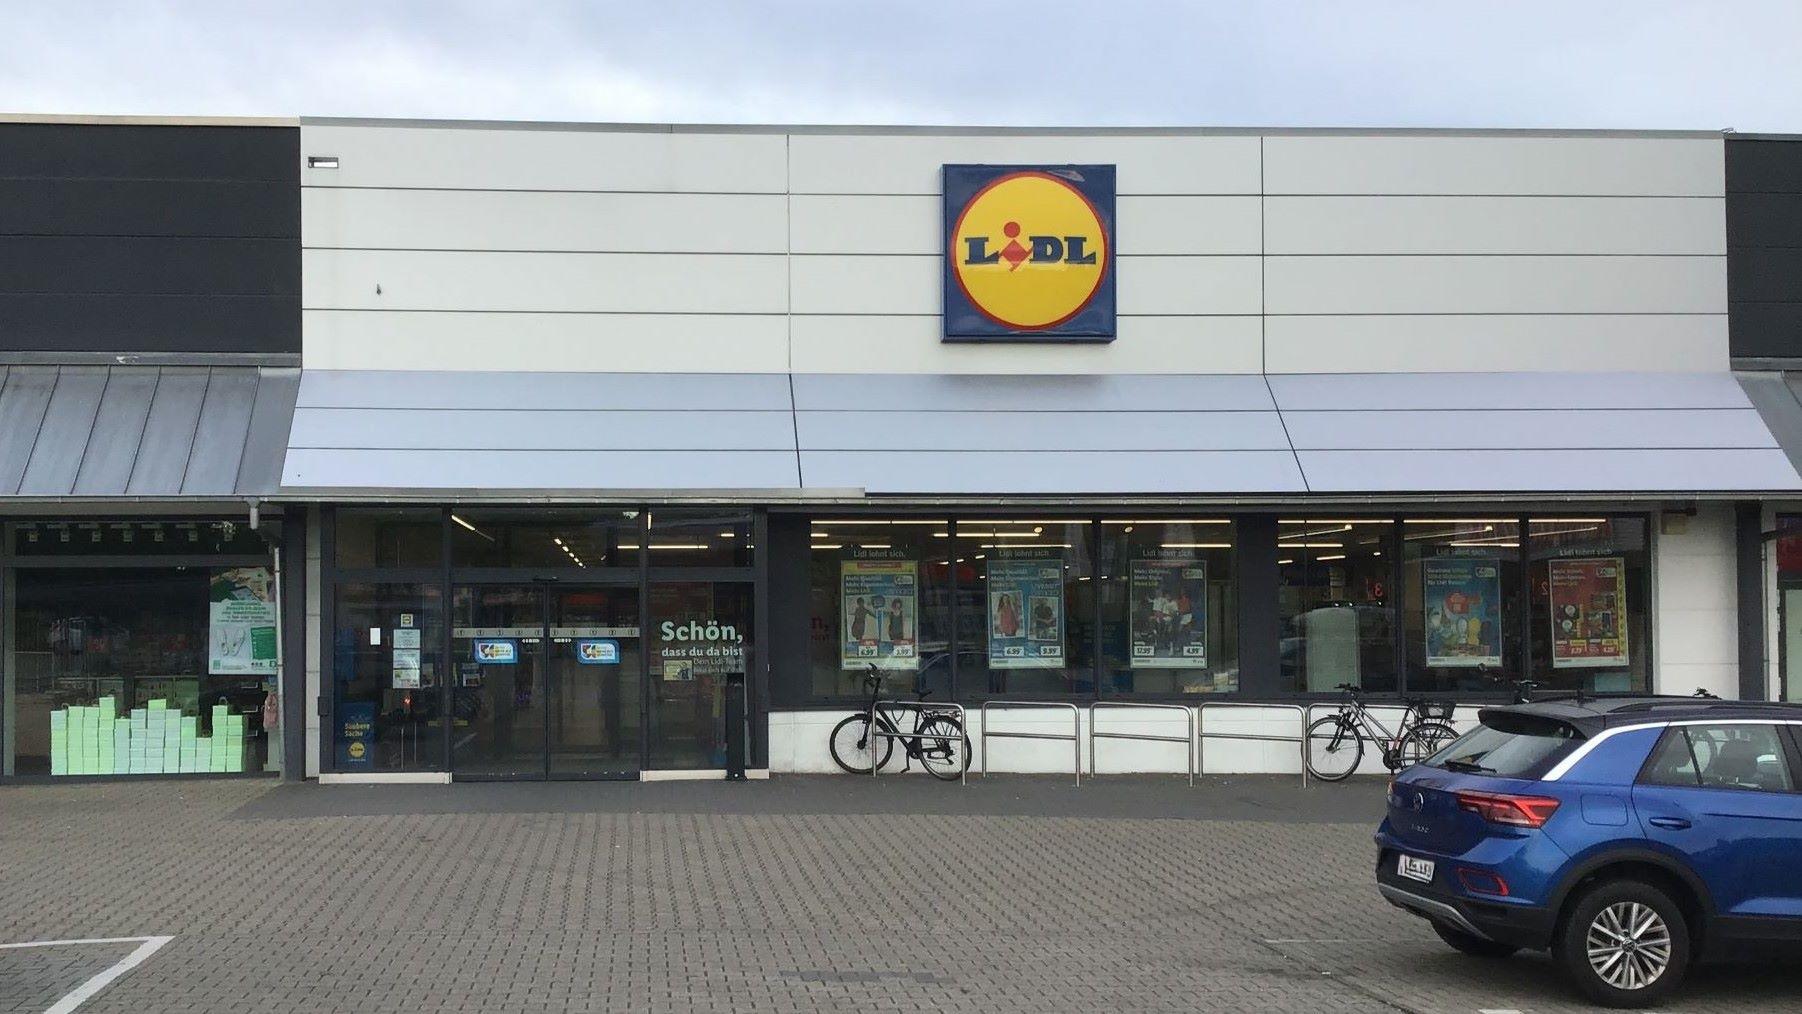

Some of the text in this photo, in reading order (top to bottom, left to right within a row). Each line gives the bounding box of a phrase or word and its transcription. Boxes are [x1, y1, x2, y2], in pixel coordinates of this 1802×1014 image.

[964, 222, 1096, 272] LIDL
[853, 550, 867, 558] Lidl
[869, 550, 888, 558] lohnt
[661, 620, 743, 644] Schön,
[661, 647, 743, 657] dass du da bist
